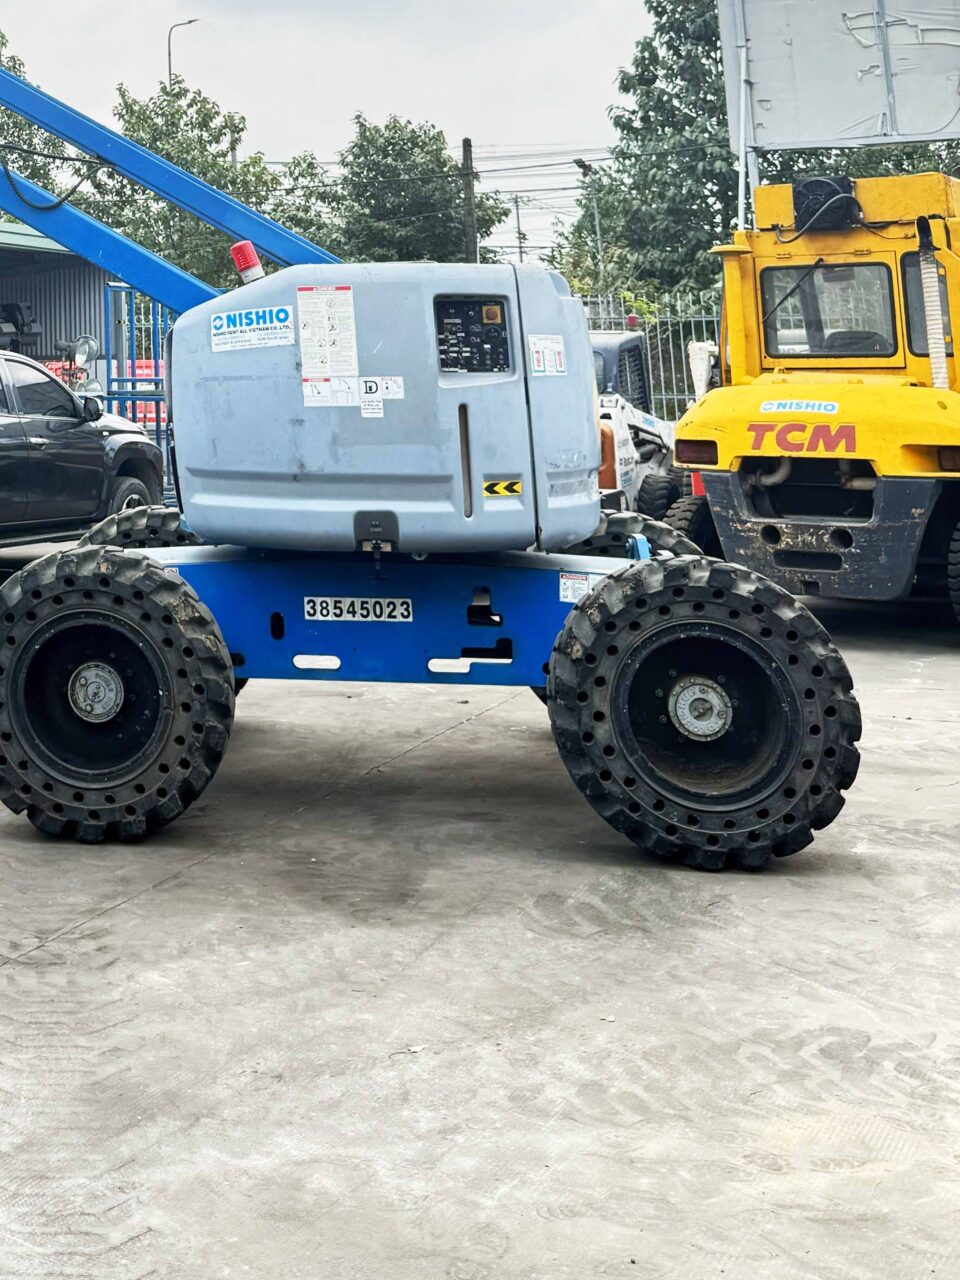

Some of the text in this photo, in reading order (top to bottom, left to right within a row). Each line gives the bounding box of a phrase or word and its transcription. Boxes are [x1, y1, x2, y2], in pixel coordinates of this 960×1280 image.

[226, 308, 290, 329] NISHIO
[776, 401, 837, 412] NISHIO
[746, 422, 856, 453] TCM
[306, 599, 411, 619] 38545023
